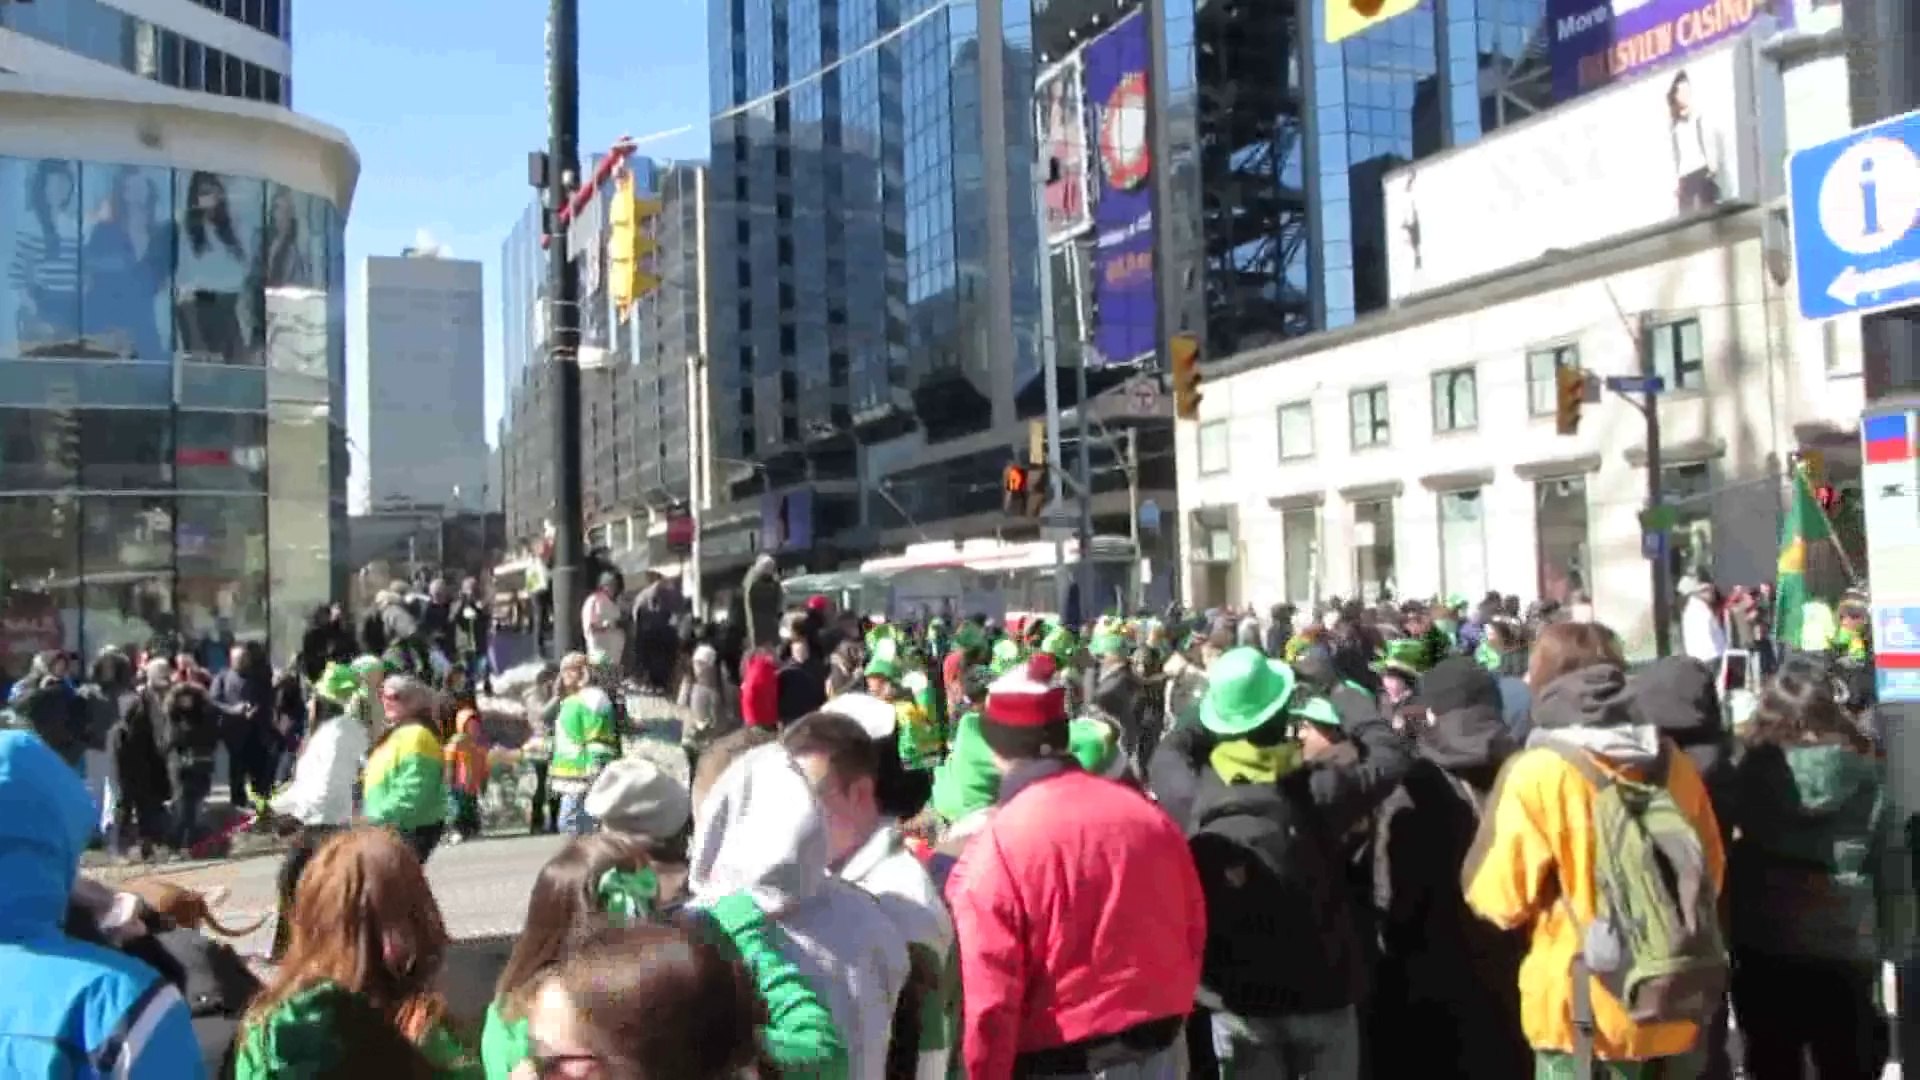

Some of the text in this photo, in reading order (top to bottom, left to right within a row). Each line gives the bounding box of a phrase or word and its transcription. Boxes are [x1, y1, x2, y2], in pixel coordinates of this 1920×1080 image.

[1557, 6, 1607, 41] More
[1578, 0, 1752, 90] LSVIEW CASINO
